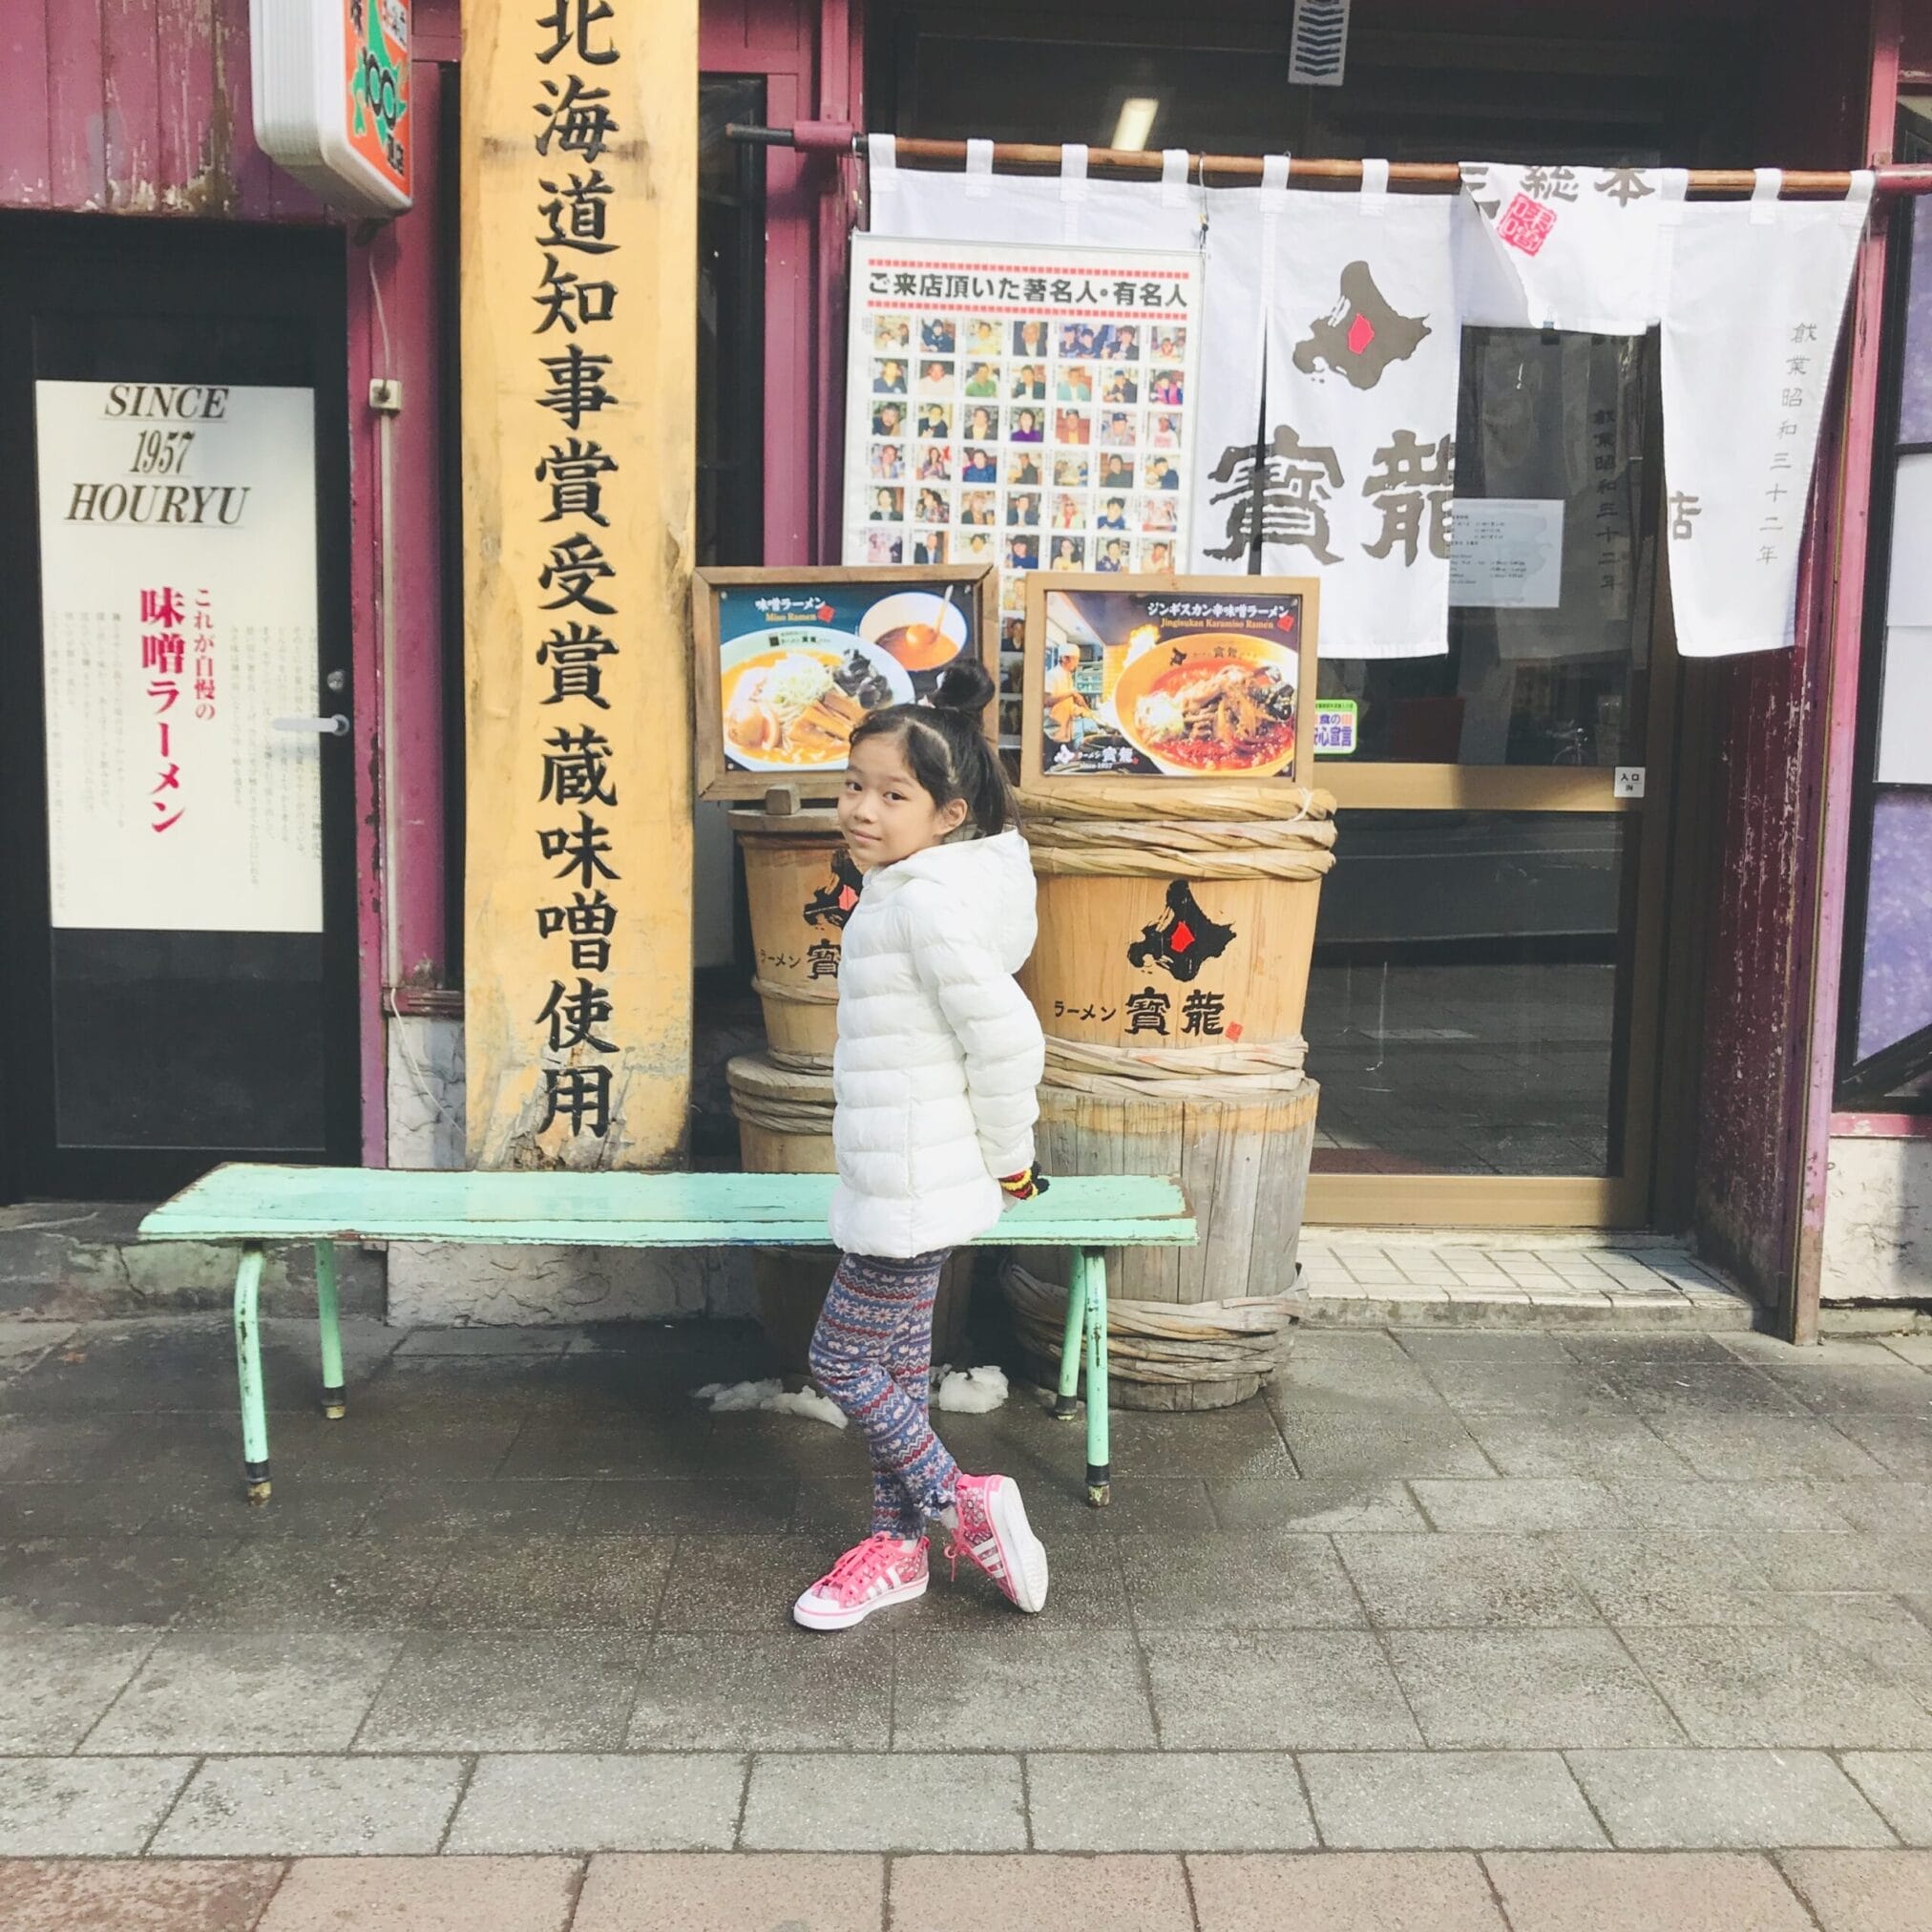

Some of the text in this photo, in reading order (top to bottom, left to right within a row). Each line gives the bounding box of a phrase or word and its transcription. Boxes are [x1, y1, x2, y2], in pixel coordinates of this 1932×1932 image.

[104, 384, 230, 419] SINCE
[129, 429, 196, 474] 1957
[65, 483, 250, 524] HOURYU
[533, 0, 620, 1137] 北海道知事賞受賞蔵味噌使用
[755, 597, 826, 612] 味噌ラーメン
[1147, 601, 1290, 619] ジンギスカン辛味噌ラーメン
[1161, 619, 1204, 629] Jingisukan
[1246, 620, 1274, 629] Ramen
[193, 588, 217, 721] これが自慢の
[139, 586, 186, 833] 味噌ラーメン
[1621, 772, 1640, 782] 入口
[1054, 999, 1116, 1022] ラーメン
